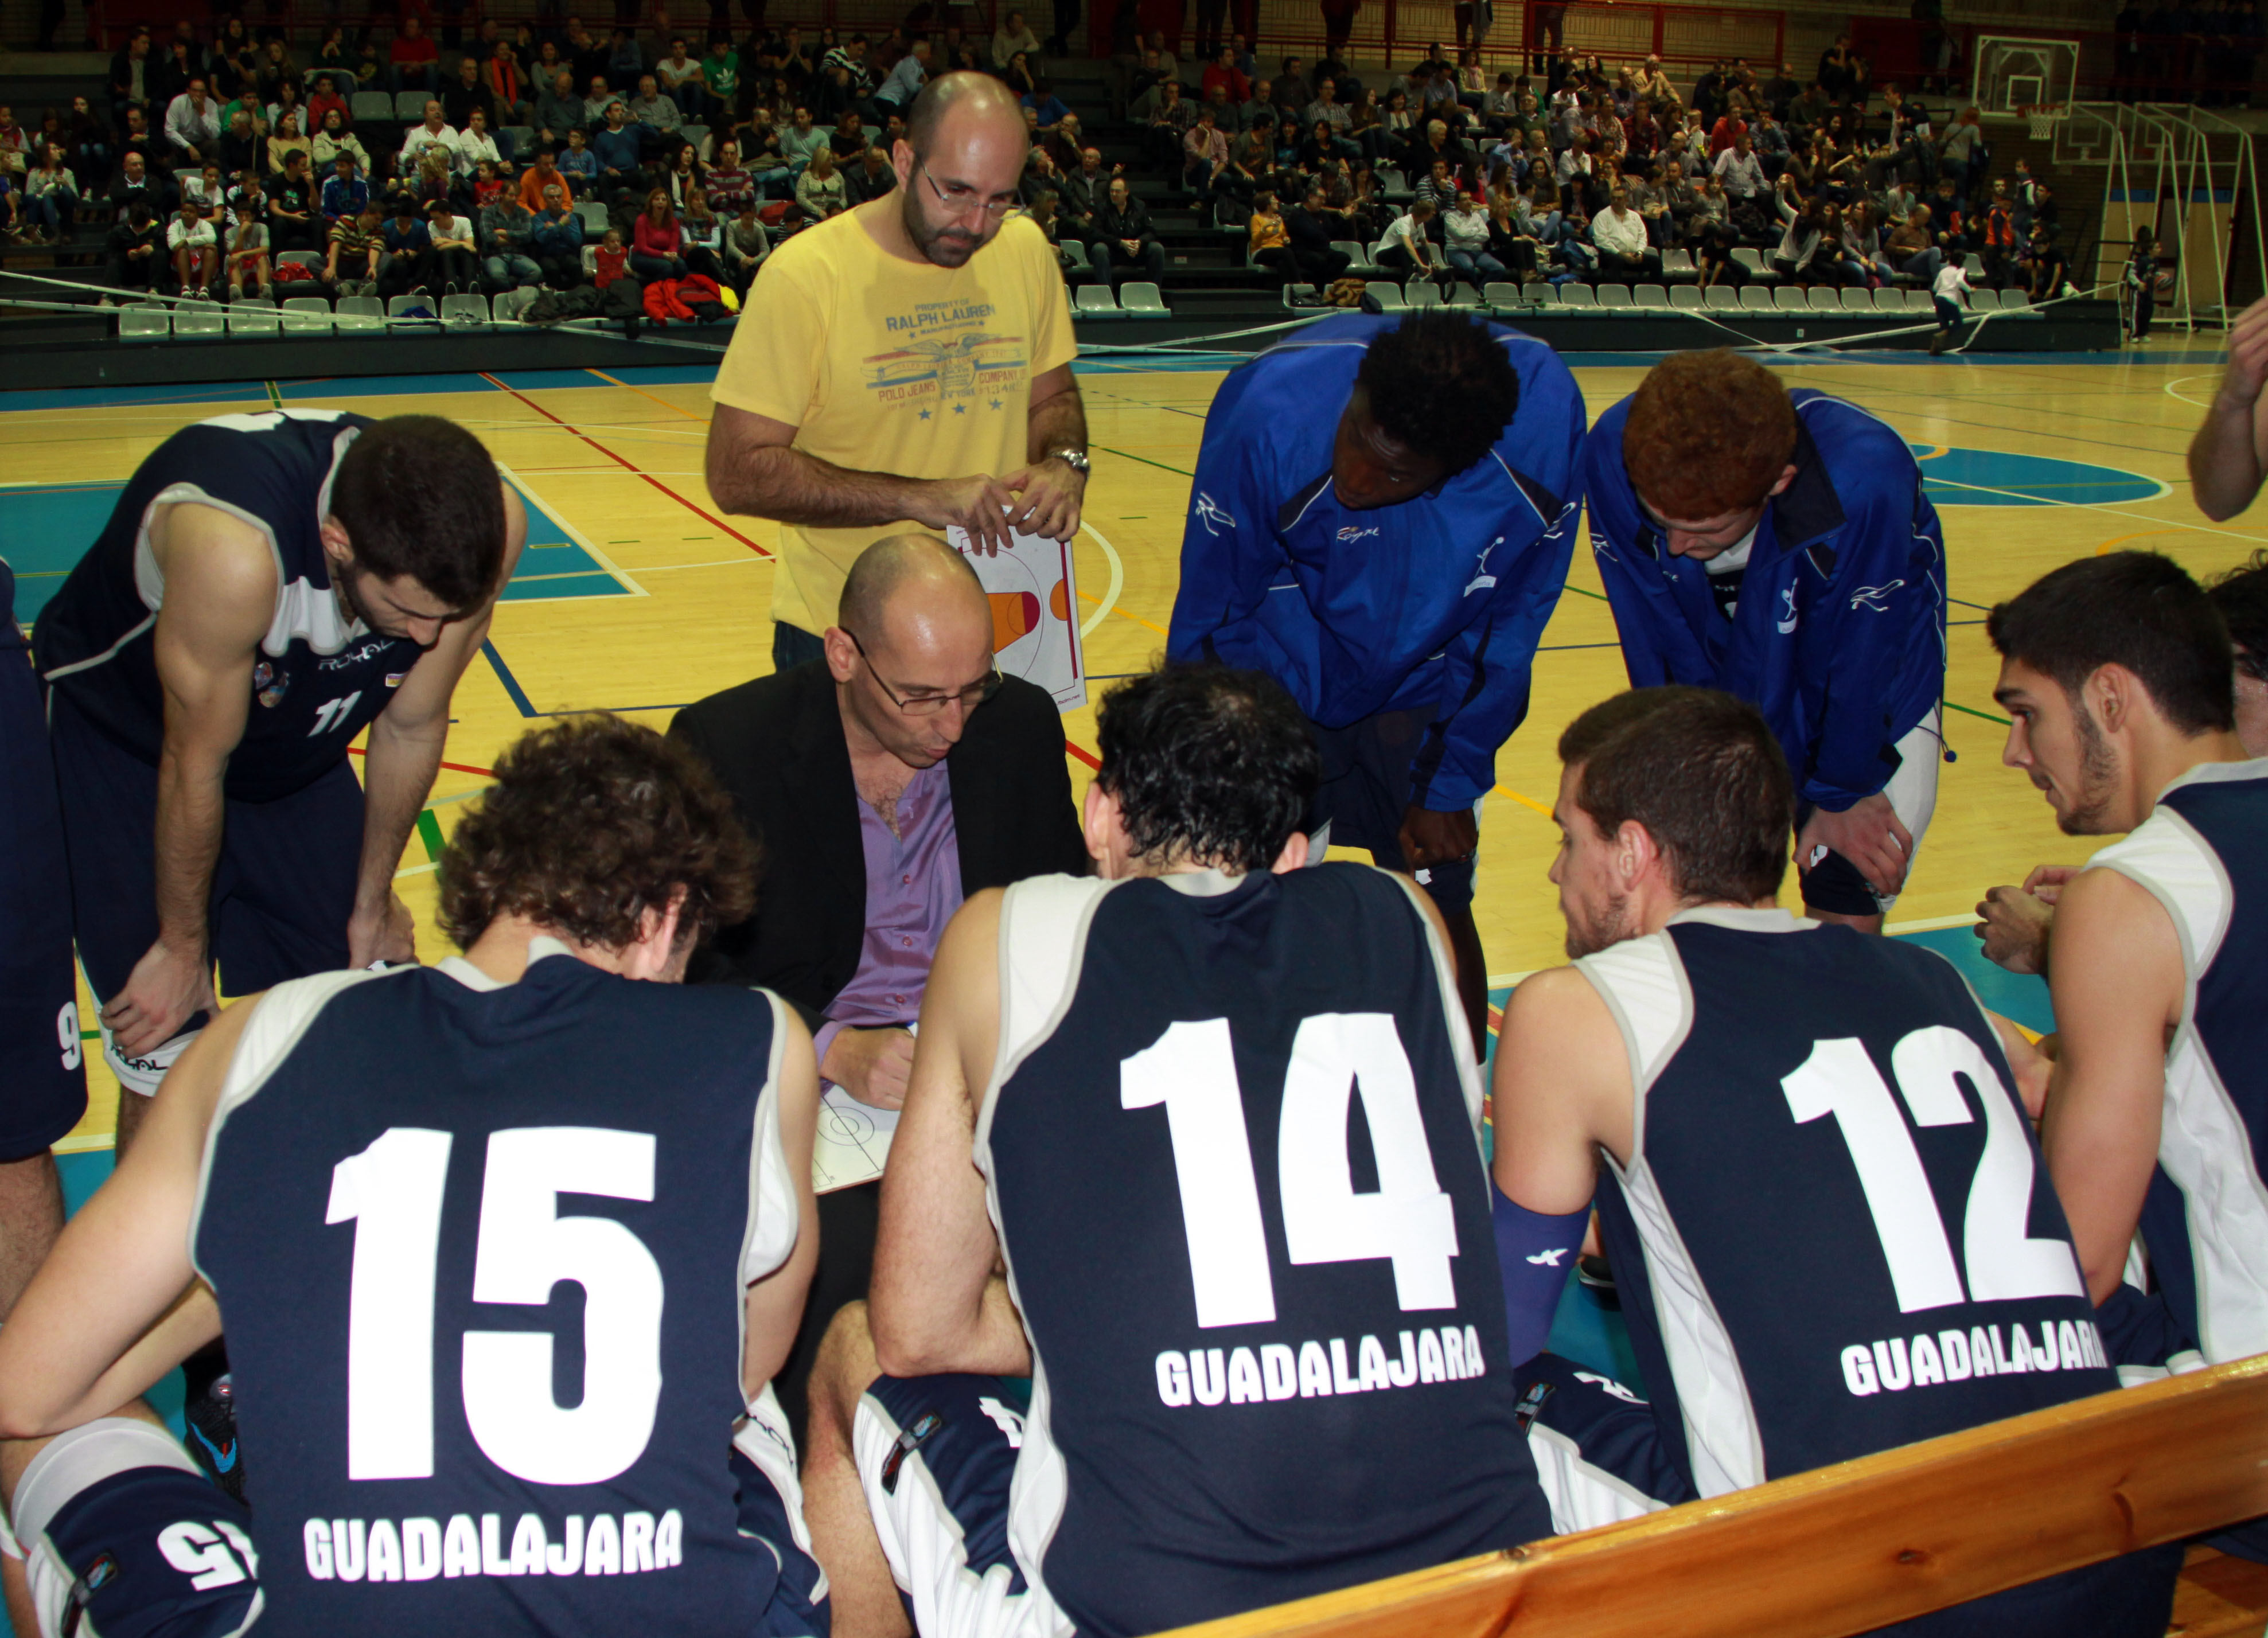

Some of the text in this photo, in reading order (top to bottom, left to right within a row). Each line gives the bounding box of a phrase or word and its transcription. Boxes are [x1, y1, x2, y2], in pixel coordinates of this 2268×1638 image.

[886, 303, 996, 331] RALPH LAUREN
[915, 299, 958, 311] PROPERTY
[878, 381, 936, 403] POLO JEANS
[979, 369, 1017, 383] COMPANY
[318, 639, 395, 670] ROYAL
[307, 690, 363, 738] 11
[58, 1001, 81, 1071] 9
[1120, 1012, 1460, 1328] 14
[1780, 1024, 2086, 1313] 12
[324, 1125, 664, 1485] 15
[1155, 1324, 1486, 1407] GUADALAJARA
[1840, 1320, 2109, 1397] GUADALAJARA
[303, 1508, 683, 1582] GUADALAJARA
